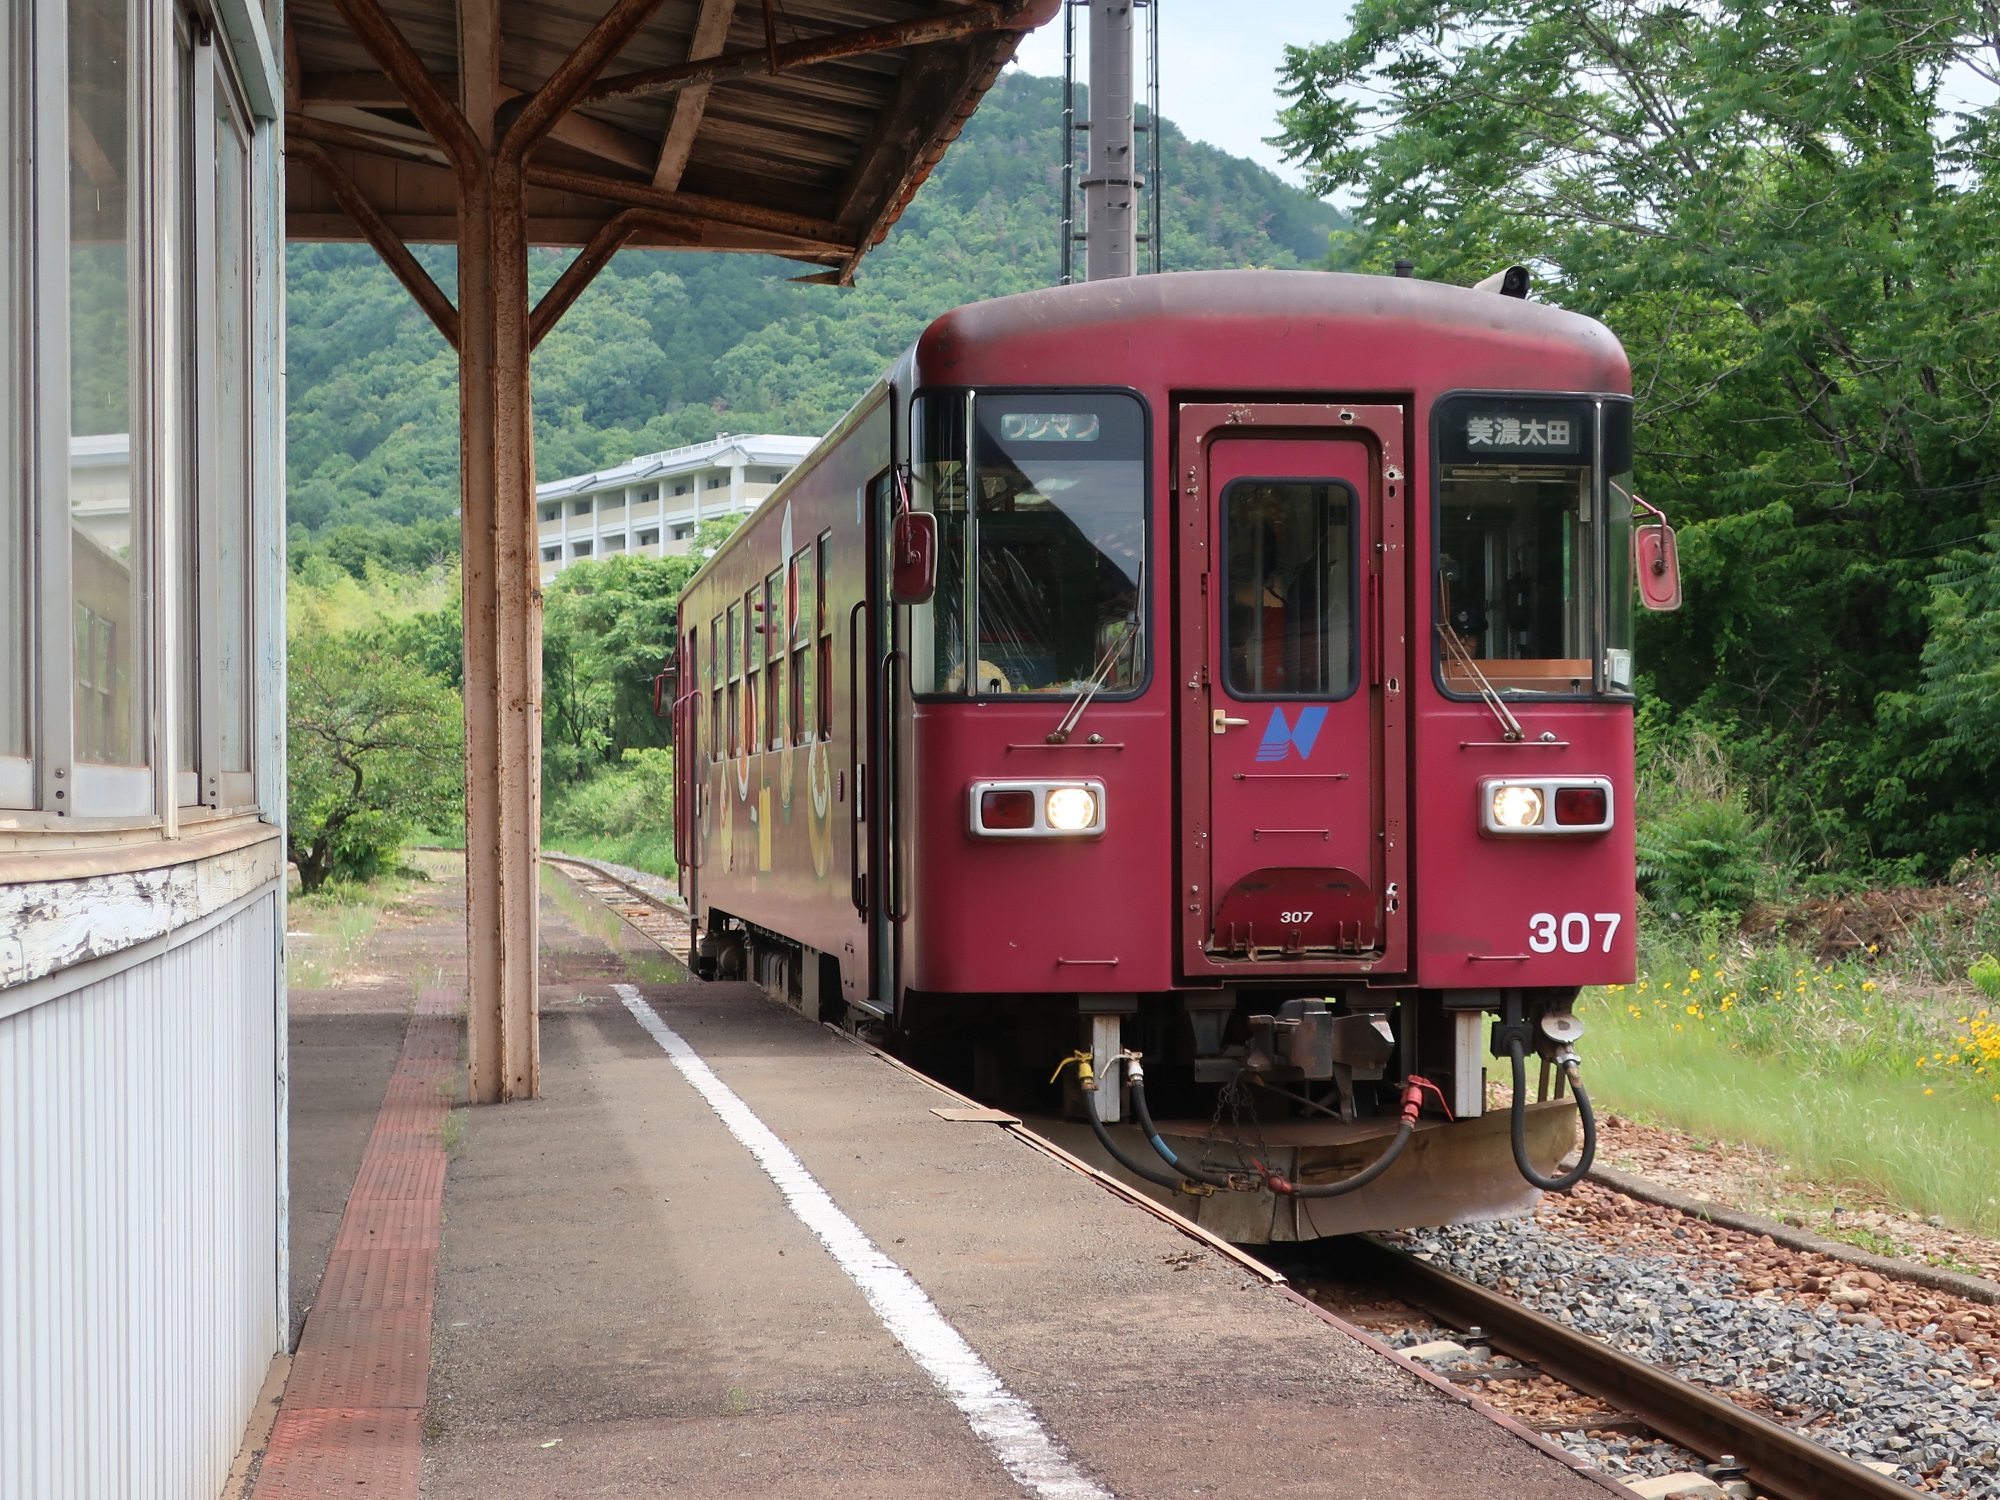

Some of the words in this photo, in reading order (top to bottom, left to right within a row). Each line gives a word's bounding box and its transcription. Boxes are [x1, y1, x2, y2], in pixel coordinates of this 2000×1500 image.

[1468, 416, 1570, 446] 美濃太田
[1280, 911, 1314, 924] 307
[1528, 912, 1622, 954] 307
